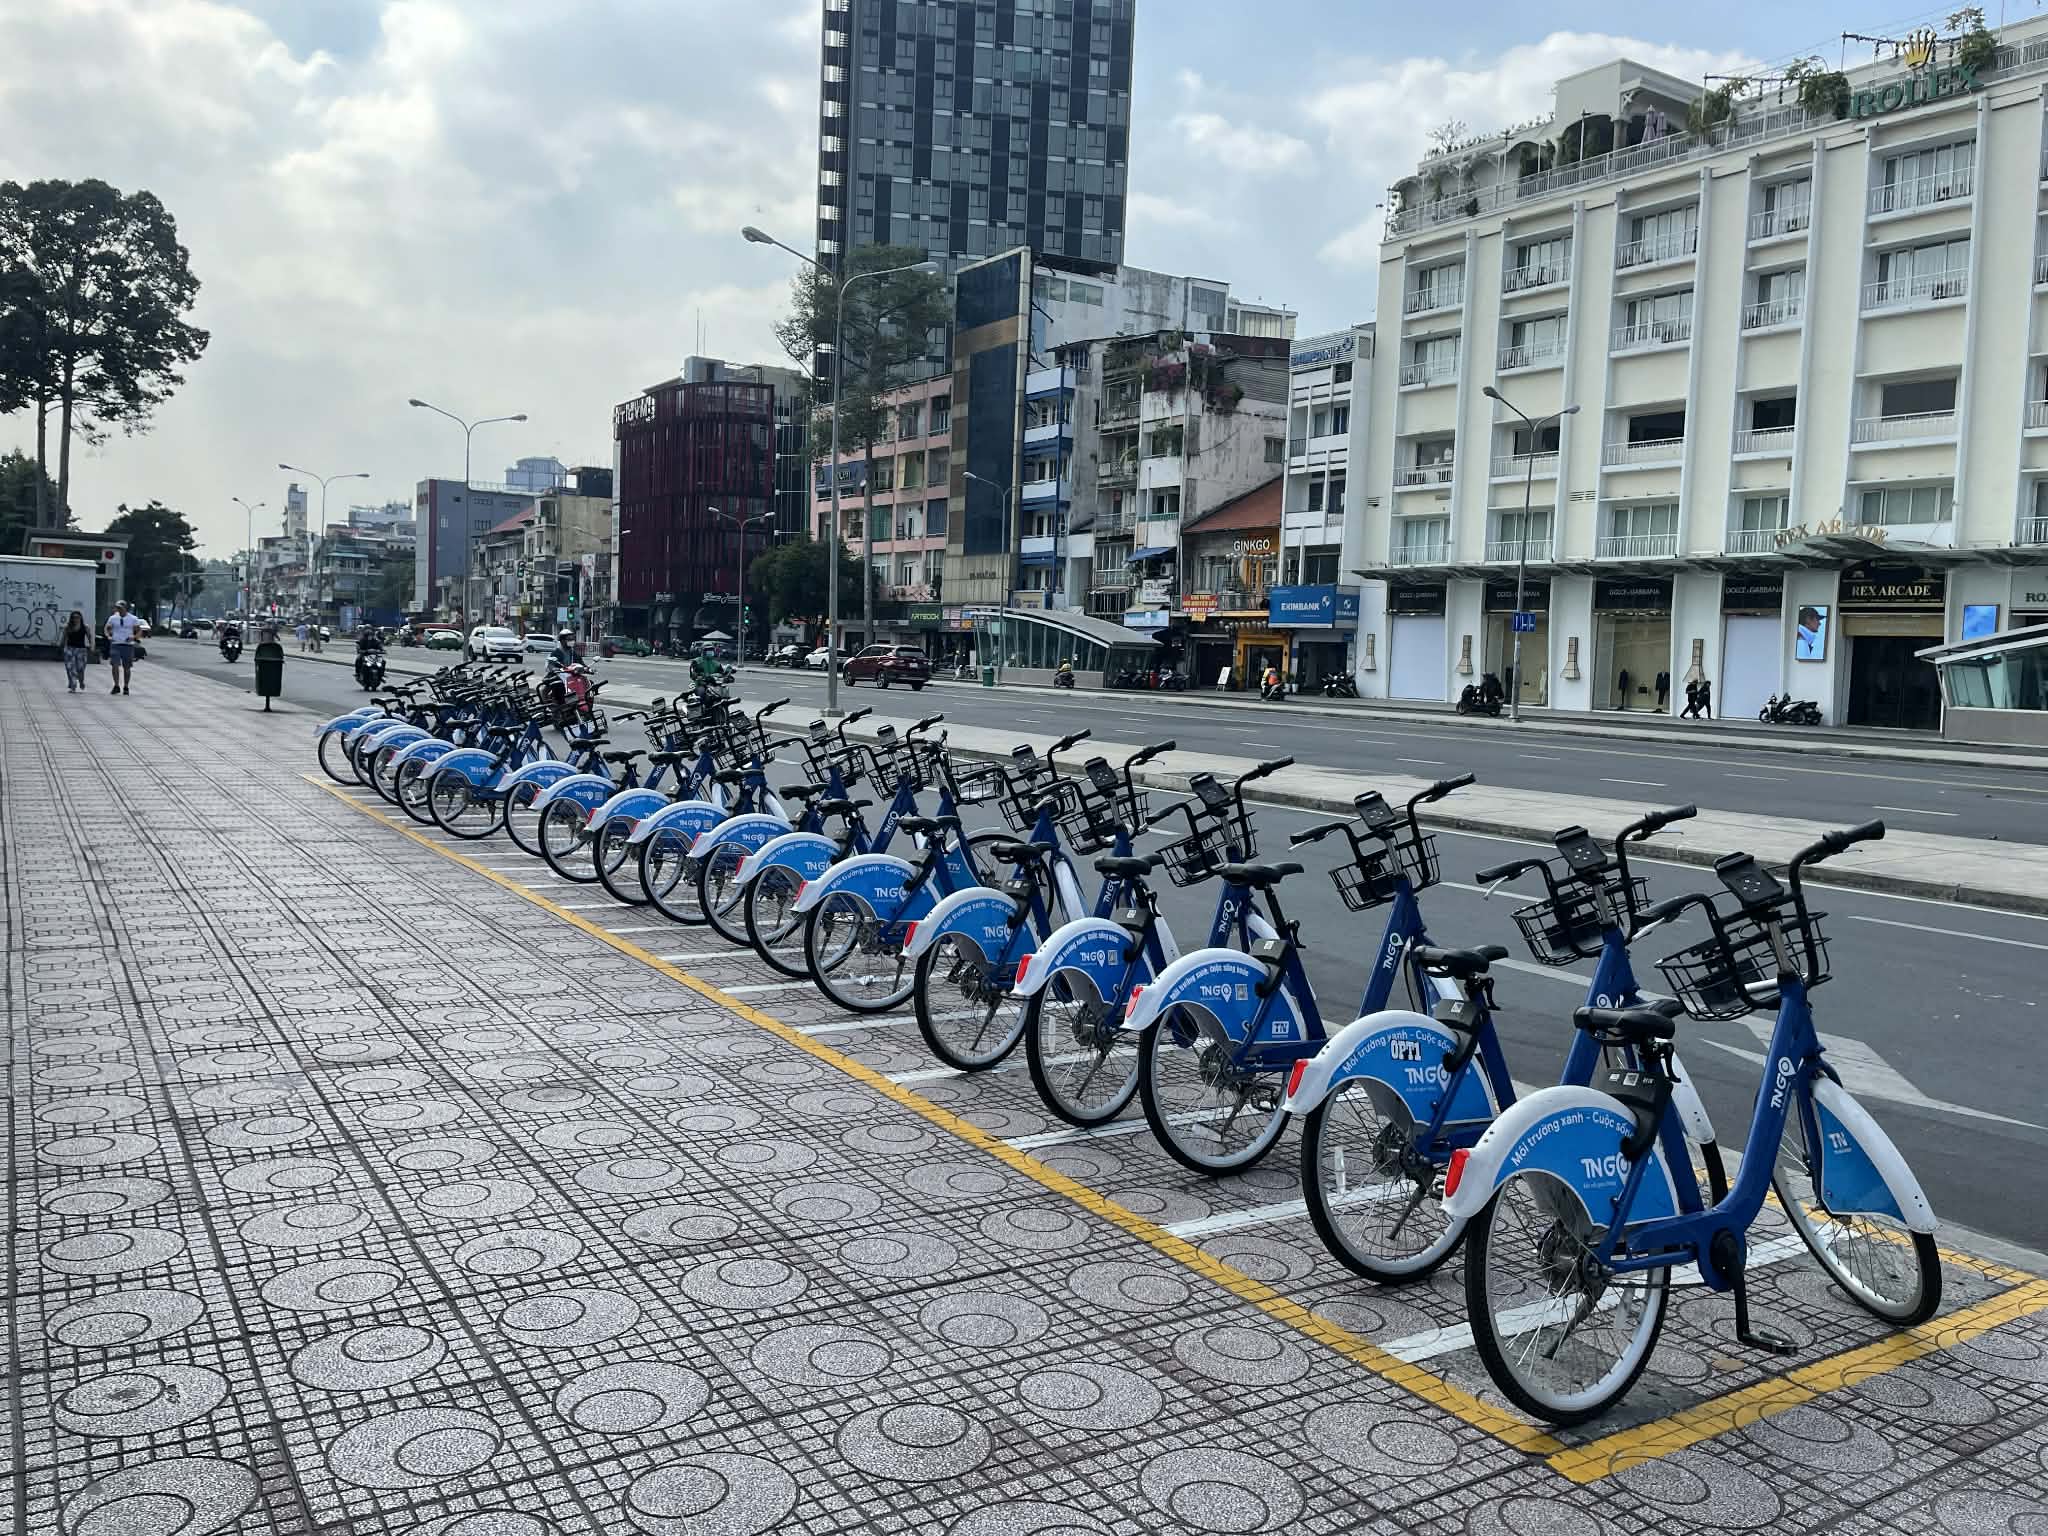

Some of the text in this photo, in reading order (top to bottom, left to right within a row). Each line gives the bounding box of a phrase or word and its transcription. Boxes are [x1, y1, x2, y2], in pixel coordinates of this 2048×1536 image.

[1233, 538, 1270, 551] GINKGO
[1852, 585, 1931, 596] REX ARCADE
[1280, 602, 1320, 611] EXIMBANK
[1218, 899, 1235, 933] TNGO
[1383, 932, 1404, 970] TNGO
[1199, 983, 1232, 1003] TNGO
[1770, 1056, 1797, 1109] TNGO
[1510, 1142, 1530, 1167] Môi
[1527, 1118, 1561, 1148] trường
[1561, 1111, 1584, 1127] xanh
[1592, 1111, 1614, 1128] Cuộc
[1828, 1131, 1848, 1149] TN
